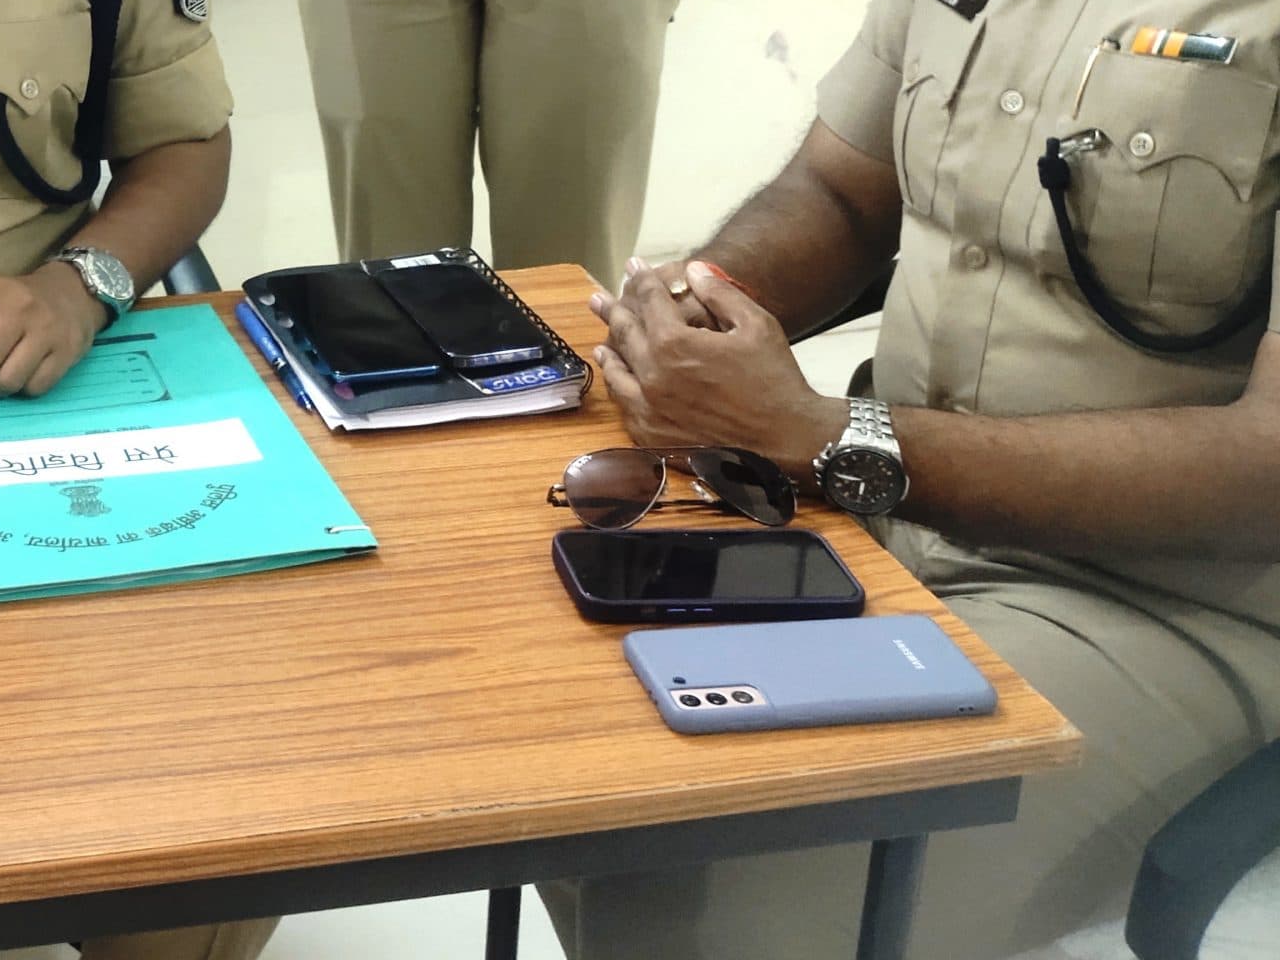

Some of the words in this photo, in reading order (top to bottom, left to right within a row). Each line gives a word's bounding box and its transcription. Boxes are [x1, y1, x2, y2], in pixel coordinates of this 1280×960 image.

[124, 444, 179, 464] प्रेस
[200, 483, 238, 510] पुलिस
[145, 509, 207, 538] अधीक्षक
[116, 532, 144, 544] का
